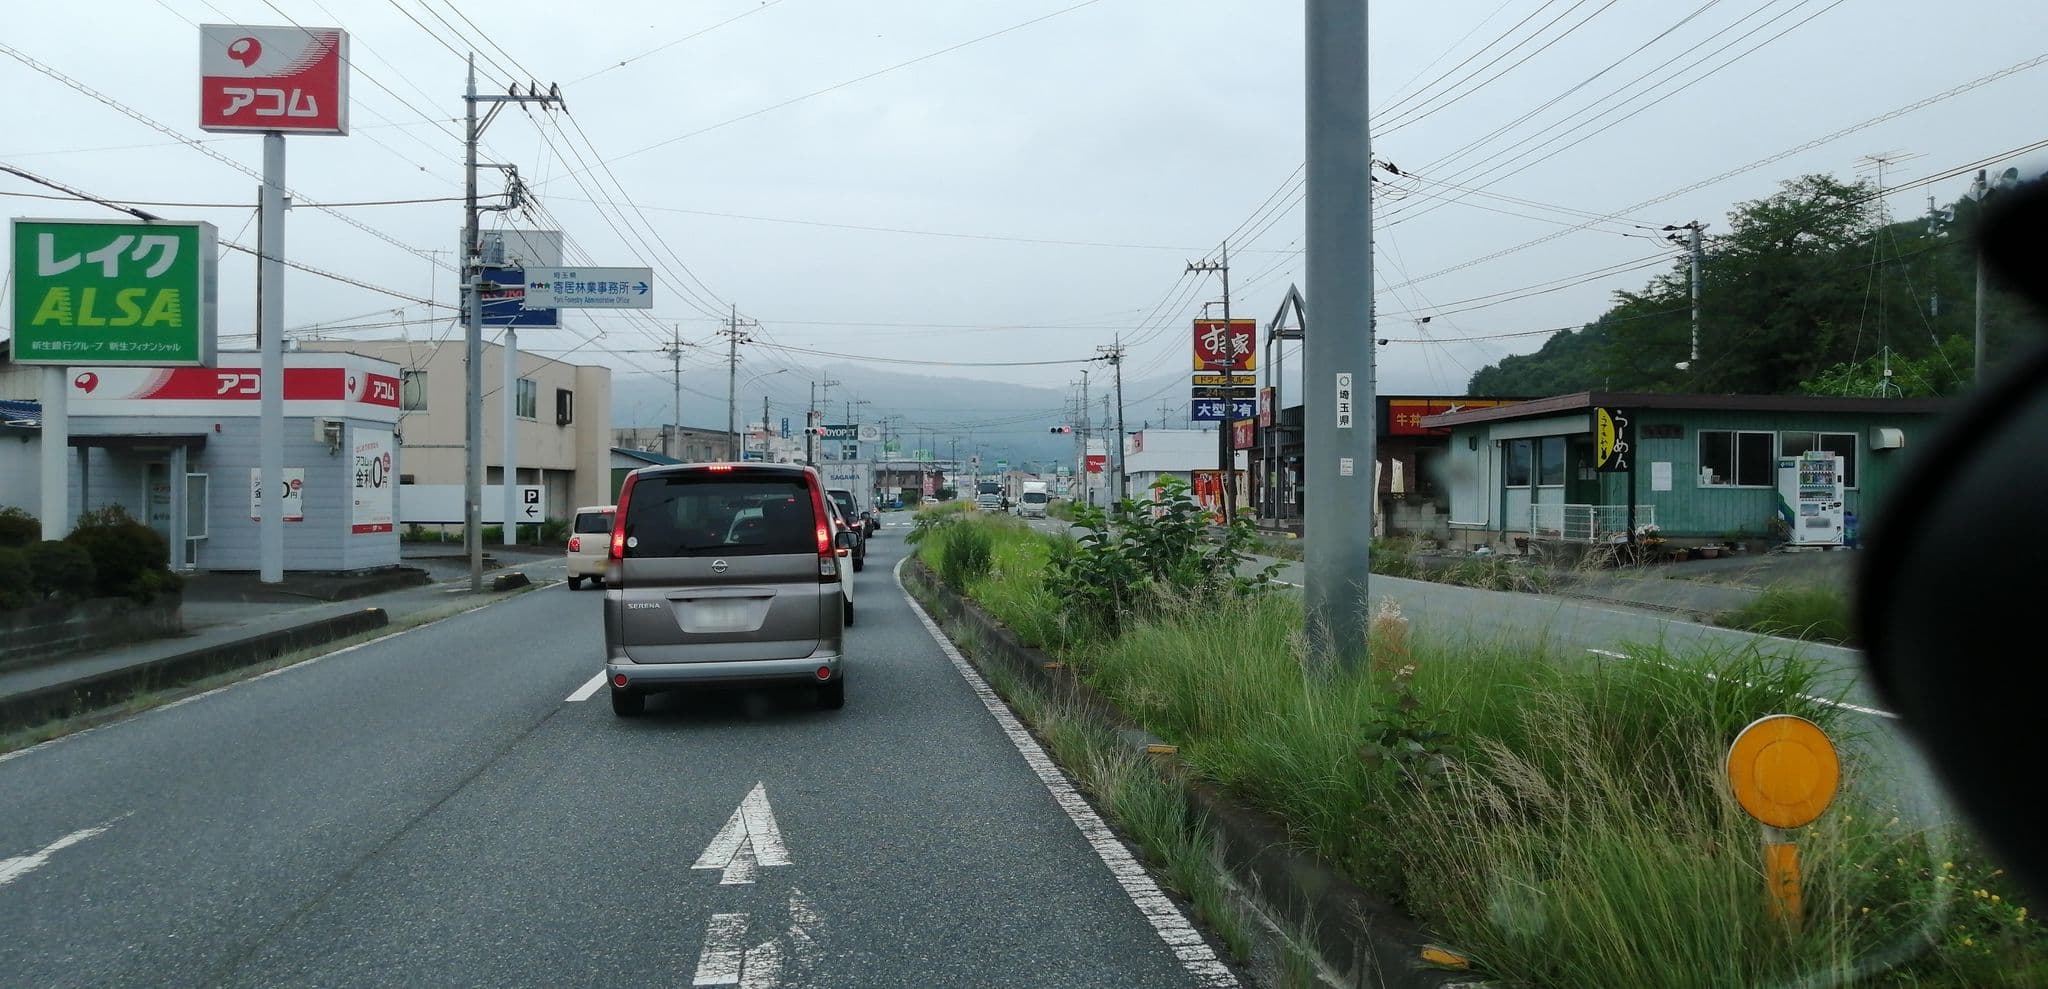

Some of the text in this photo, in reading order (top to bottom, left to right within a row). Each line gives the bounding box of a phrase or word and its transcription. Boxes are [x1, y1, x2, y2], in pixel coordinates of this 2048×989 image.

[223, 87, 319, 117] アコム
[38, 233, 180, 278] レイク
[553, 281, 630, 295] 寄居林業事務所
[32, 287, 182, 327] ALSA
[373, 380, 395, 400] アコム
[1339, 389, 1350, 426] 埼玉県
[1396, 412, 1421, 427] 牛丼
[1613, 409, 1629, 470] らーめん
[527, 491, 537, 502] P
